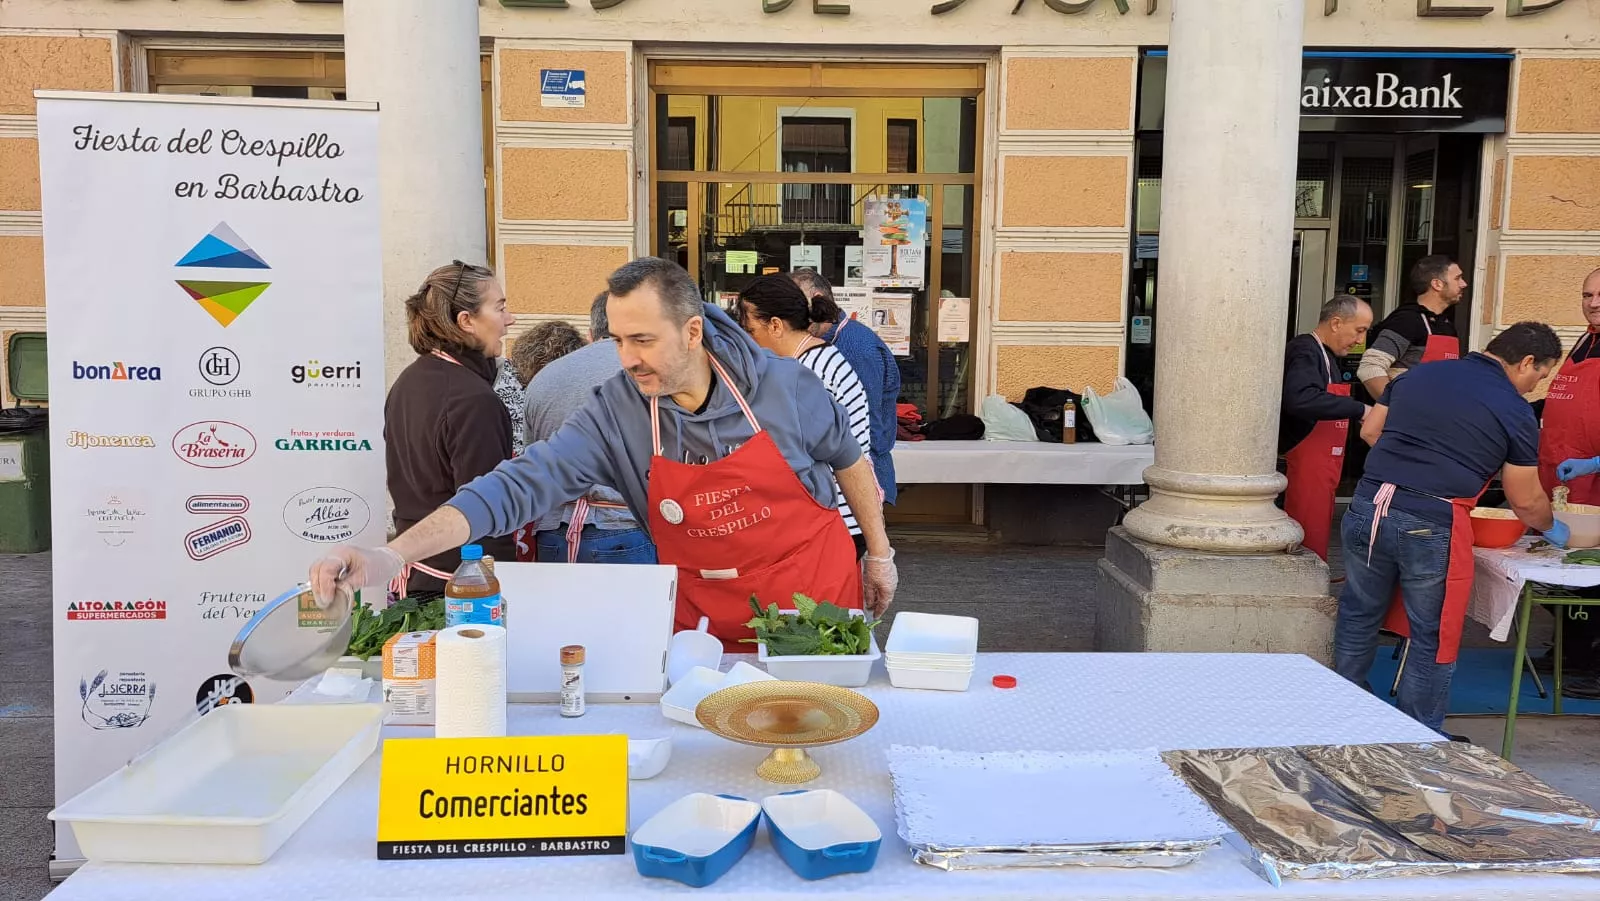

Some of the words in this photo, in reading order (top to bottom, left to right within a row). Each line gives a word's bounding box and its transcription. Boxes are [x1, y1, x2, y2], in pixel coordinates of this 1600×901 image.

[1301, 72, 1463, 109] aixaBank
[73, 124, 160, 152] Fiesta
[167, 128, 212, 154] del
[221, 129, 344, 167] Crespillo
[174, 178, 207, 199] en
[215, 173, 364, 204] Barbastro
[291, 360, 361, 383] güerri
[1555, 374, 1578, 383] ESTA
[189, 389, 226, 398] GRUPO
[229, 390, 251, 398] GHB
[67, 431, 155, 449] Jijonenca
[195, 431, 212, 446] La
[290, 428, 313, 437] frutas
[315, 430, 319, 438] y
[322, 429, 355, 437] verduras
[275, 438, 373, 451] GARRIGA
[694, 485, 752, 507] FIESTA
[710, 502, 745, 520] DEL
[687, 506, 771, 537] CRESPILLO
[192, 523, 242, 549] FERNANDO
[302, 530, 352, 541] BARBASTRO
[67, 598, 166, 611] ALTOARAGÓN
[202, 606, 229, 619] del
[231, 606, 260, 619] Ver
[76, 612, 157, 620] SUPERMERCADOS
[110, 683, 146, 694] SIERRA
[446, 754, 565, 774] HORNILLO
[419, 785, 588, 819] Comerciantes
[392, 844, 432, 855] FIESTA
[438, 844, 458, 854] DEL
[463, 842, 527, 853] CRESPILLO
[540, 840, 611, 851] BARBASTRO
